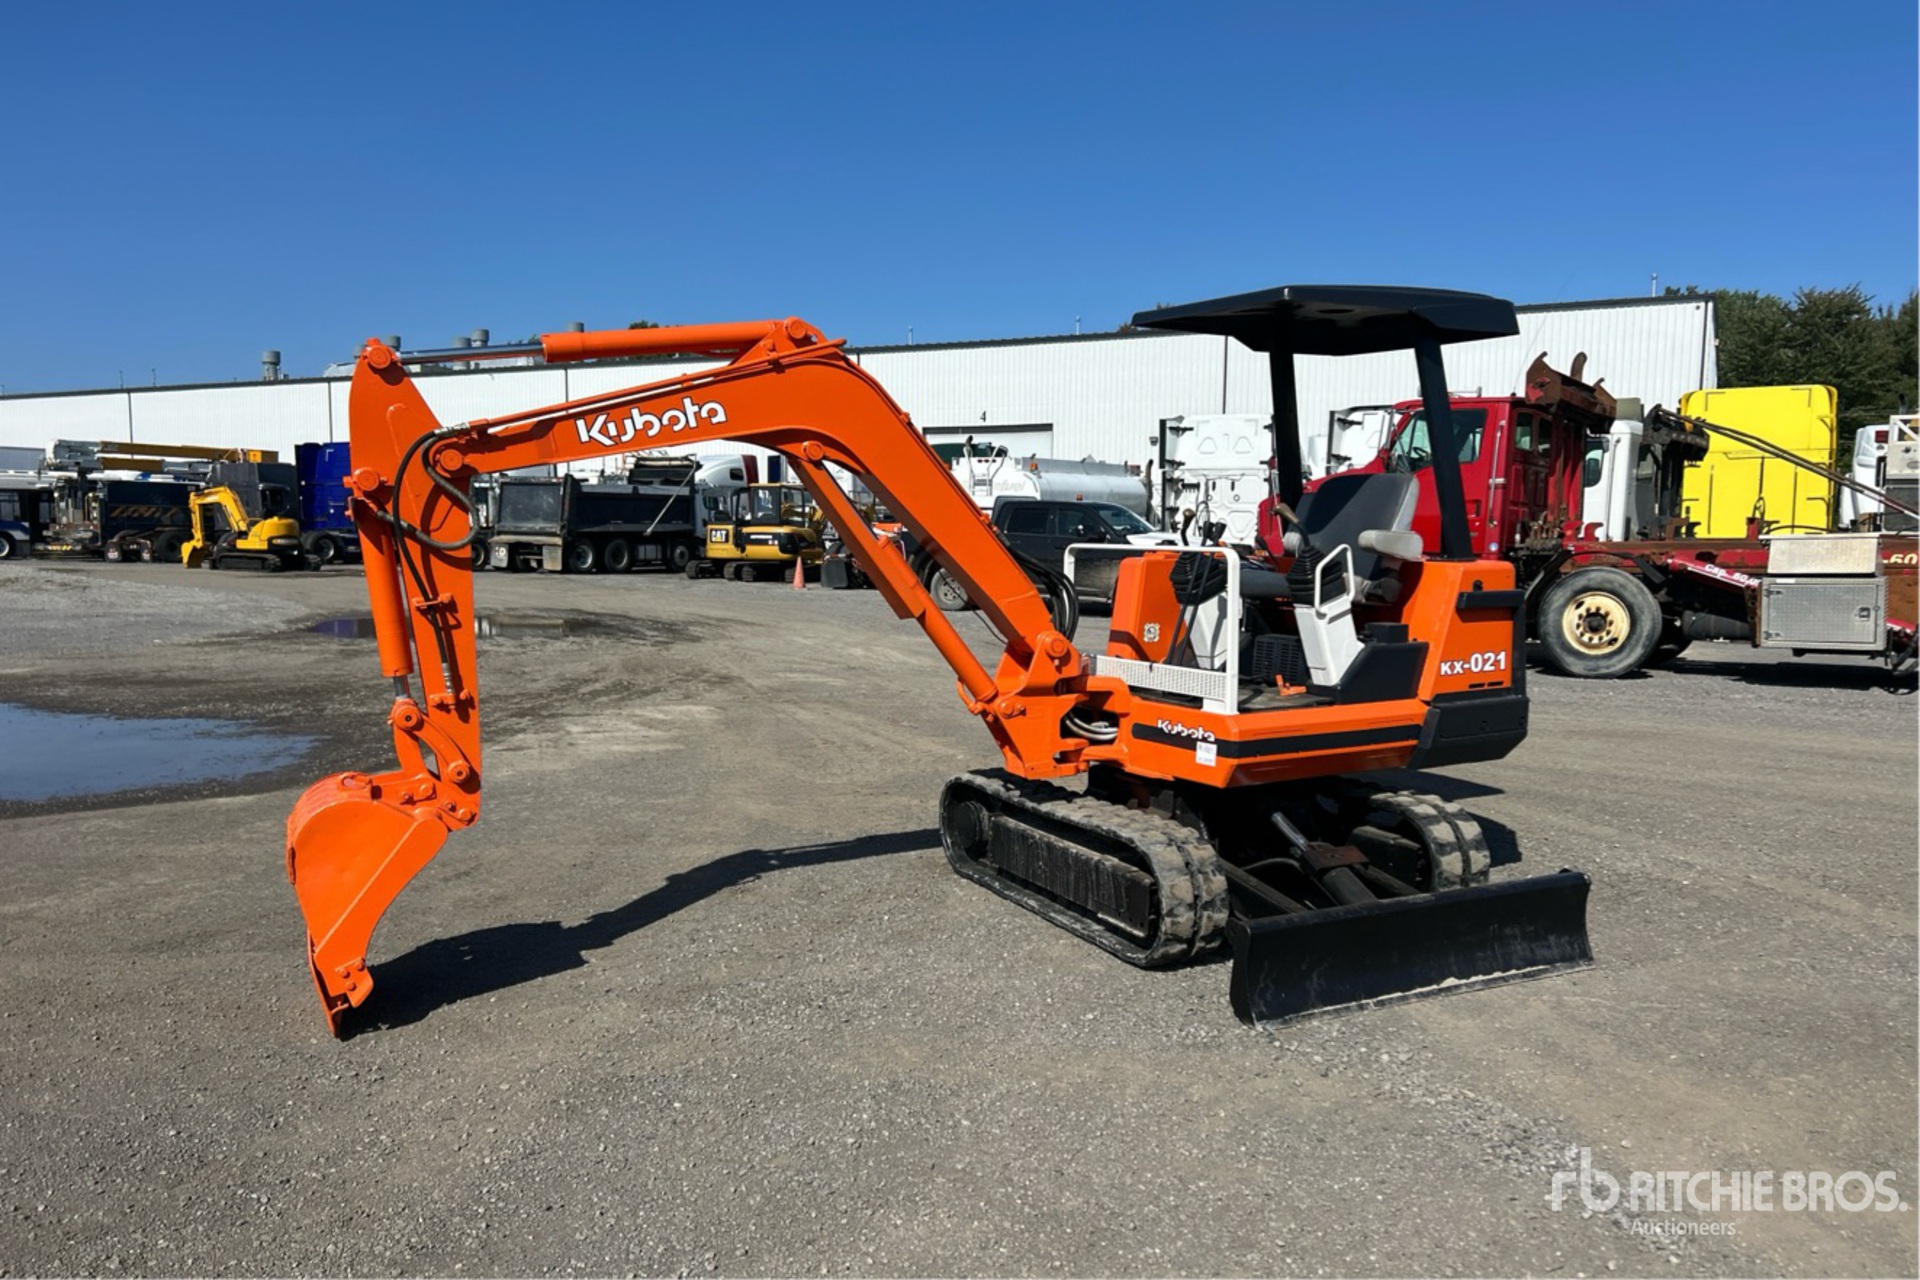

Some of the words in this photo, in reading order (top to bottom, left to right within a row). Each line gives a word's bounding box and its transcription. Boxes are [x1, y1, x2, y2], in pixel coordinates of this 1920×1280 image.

[576, 397, 727, 446] Kubota
[980, 411, 986, 422] 4
[711, 530, 728, 542] CAT
[1440, 650, 1506, 676] KX-021
[1157, 718, 1216, 742] Kubota
